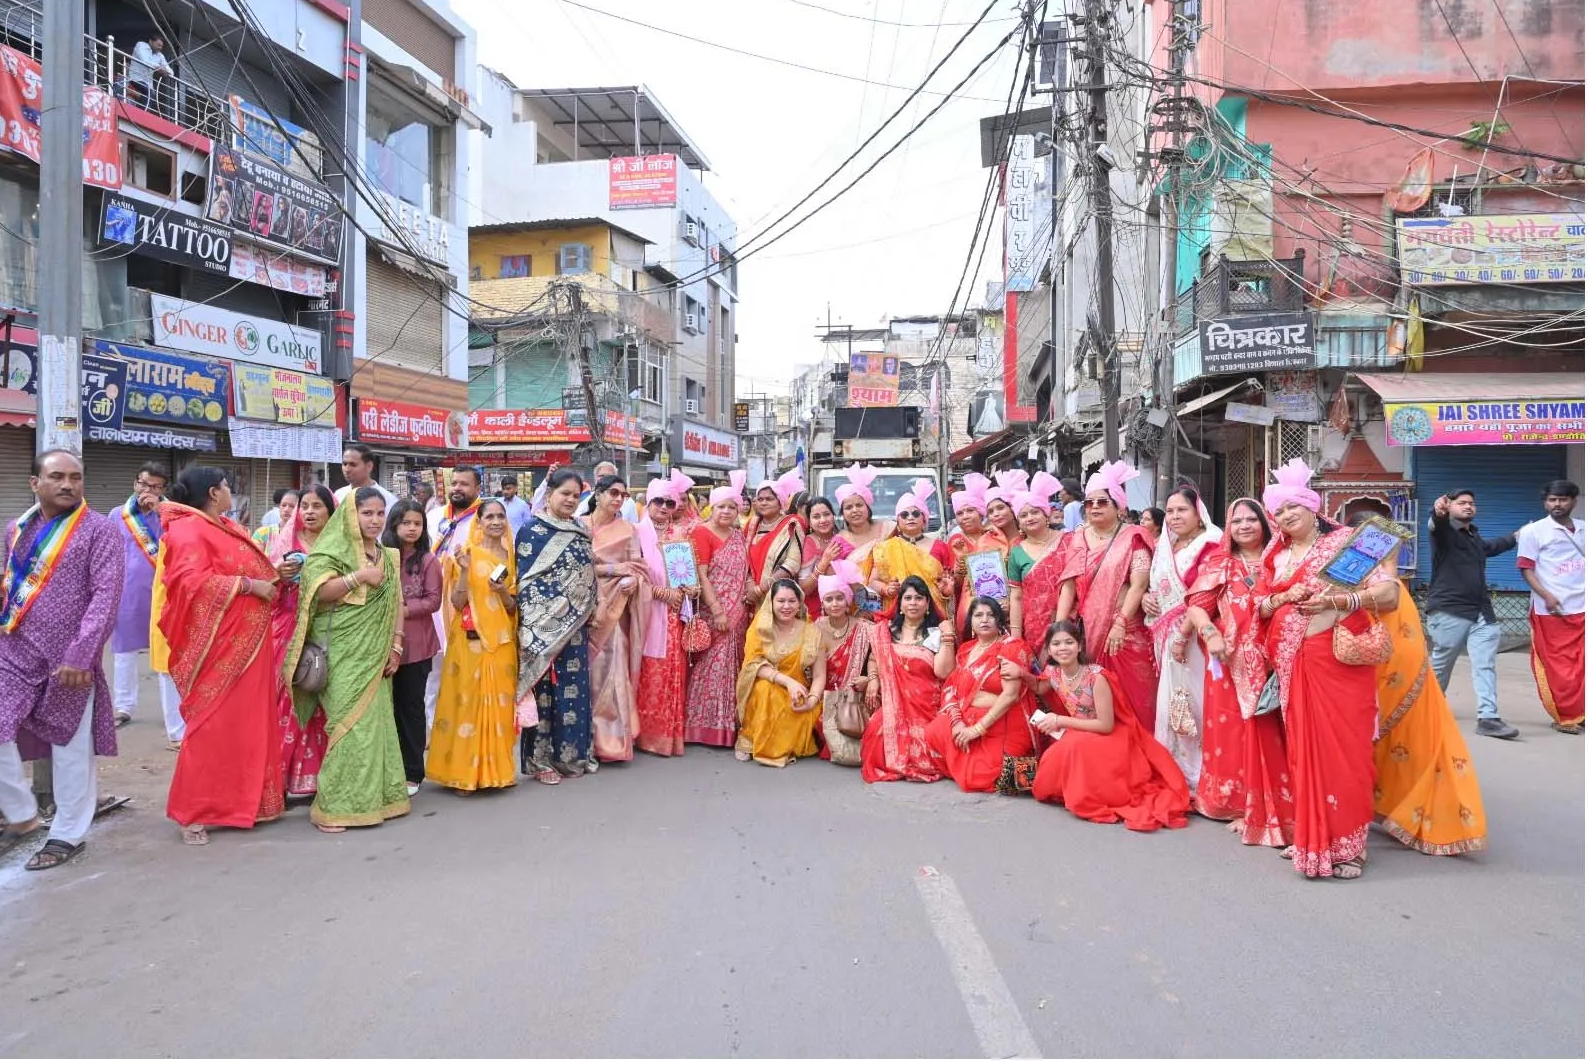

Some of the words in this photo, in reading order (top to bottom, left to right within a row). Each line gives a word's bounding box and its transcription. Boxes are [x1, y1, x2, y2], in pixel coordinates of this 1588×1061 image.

[138, 214, 229, 263] TATTOO
[204, 260, 227, 273] STUDIO
[162, 311, 228, 345] GINGER
[267, 333, 318, 361] GARLIC
[1206, 322, 1308, 352] चित्रकार
[380, 408, 408, 434] लेडीज
[1437, 404, 1463, 421] JAI
[1467, 403, 1522, 421] SHREE
[1526, 402, 1585, 420] SHYAM
